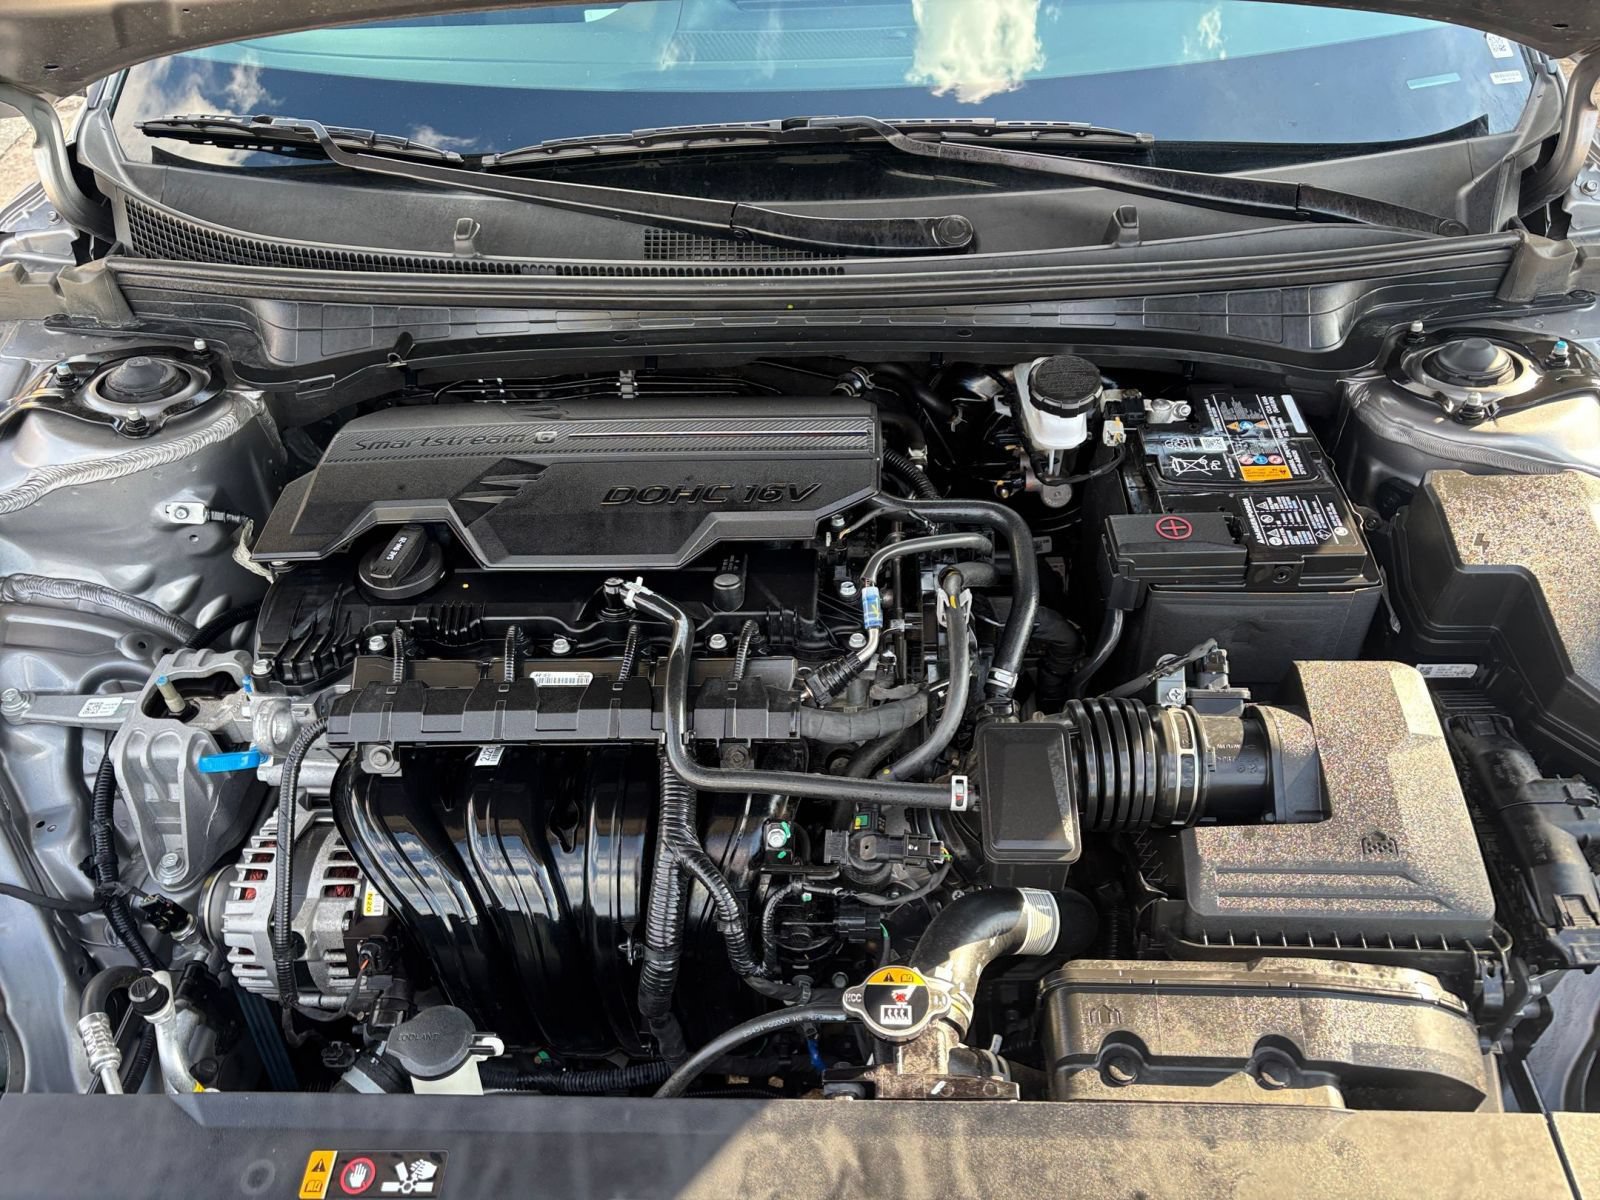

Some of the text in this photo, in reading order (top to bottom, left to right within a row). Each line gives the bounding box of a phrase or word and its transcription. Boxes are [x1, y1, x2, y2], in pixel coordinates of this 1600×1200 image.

[349, 434, 527, 452] Smartstream
[600, 482, 823, 506] DOHC 16V
